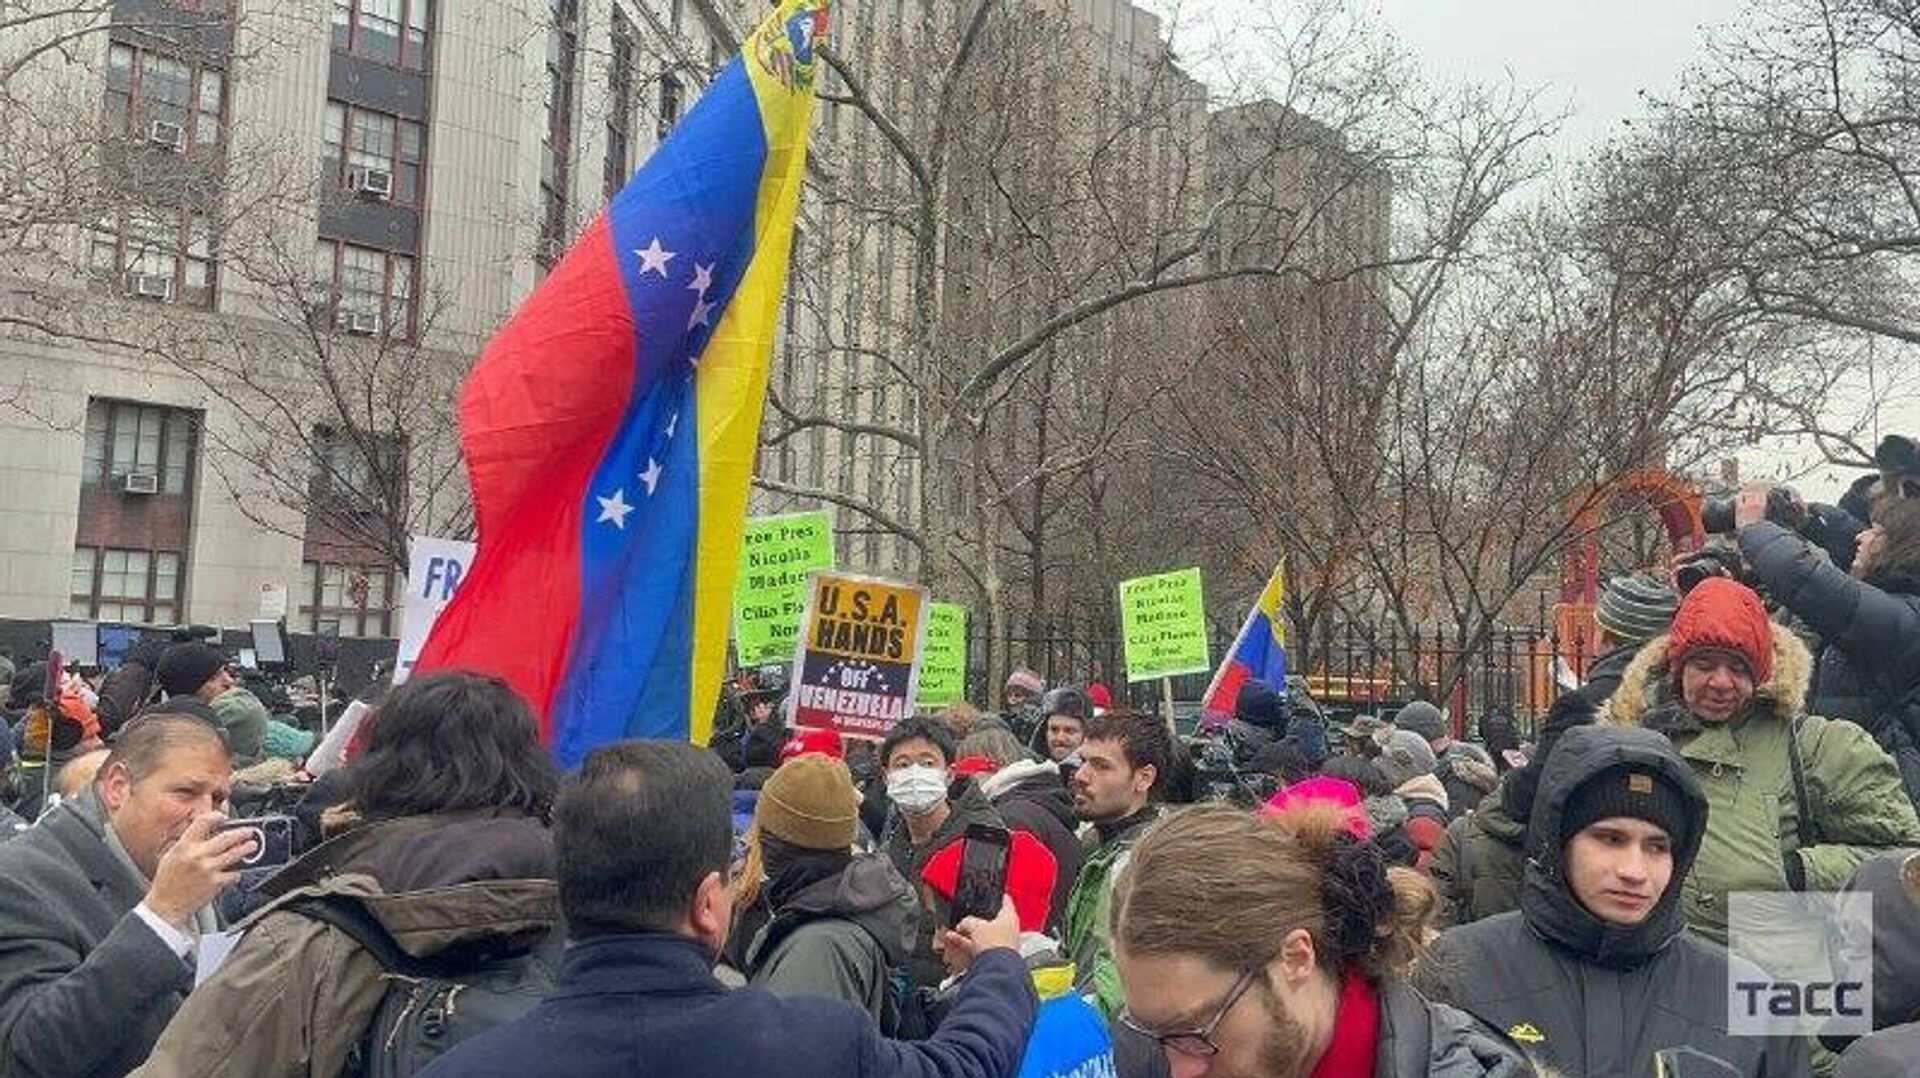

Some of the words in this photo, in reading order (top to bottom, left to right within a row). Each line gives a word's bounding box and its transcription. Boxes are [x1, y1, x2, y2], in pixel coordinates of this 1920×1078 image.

[423, 557, 463, 600] FR
[749, 571, 809, 590] Madur
[819, 585, 907, 626] U.S.A.
[816, 617, 905, 659] HANDS
[841, 666, 870, 689] OFF
[799, 683, 904, 722] VENEZUELA
